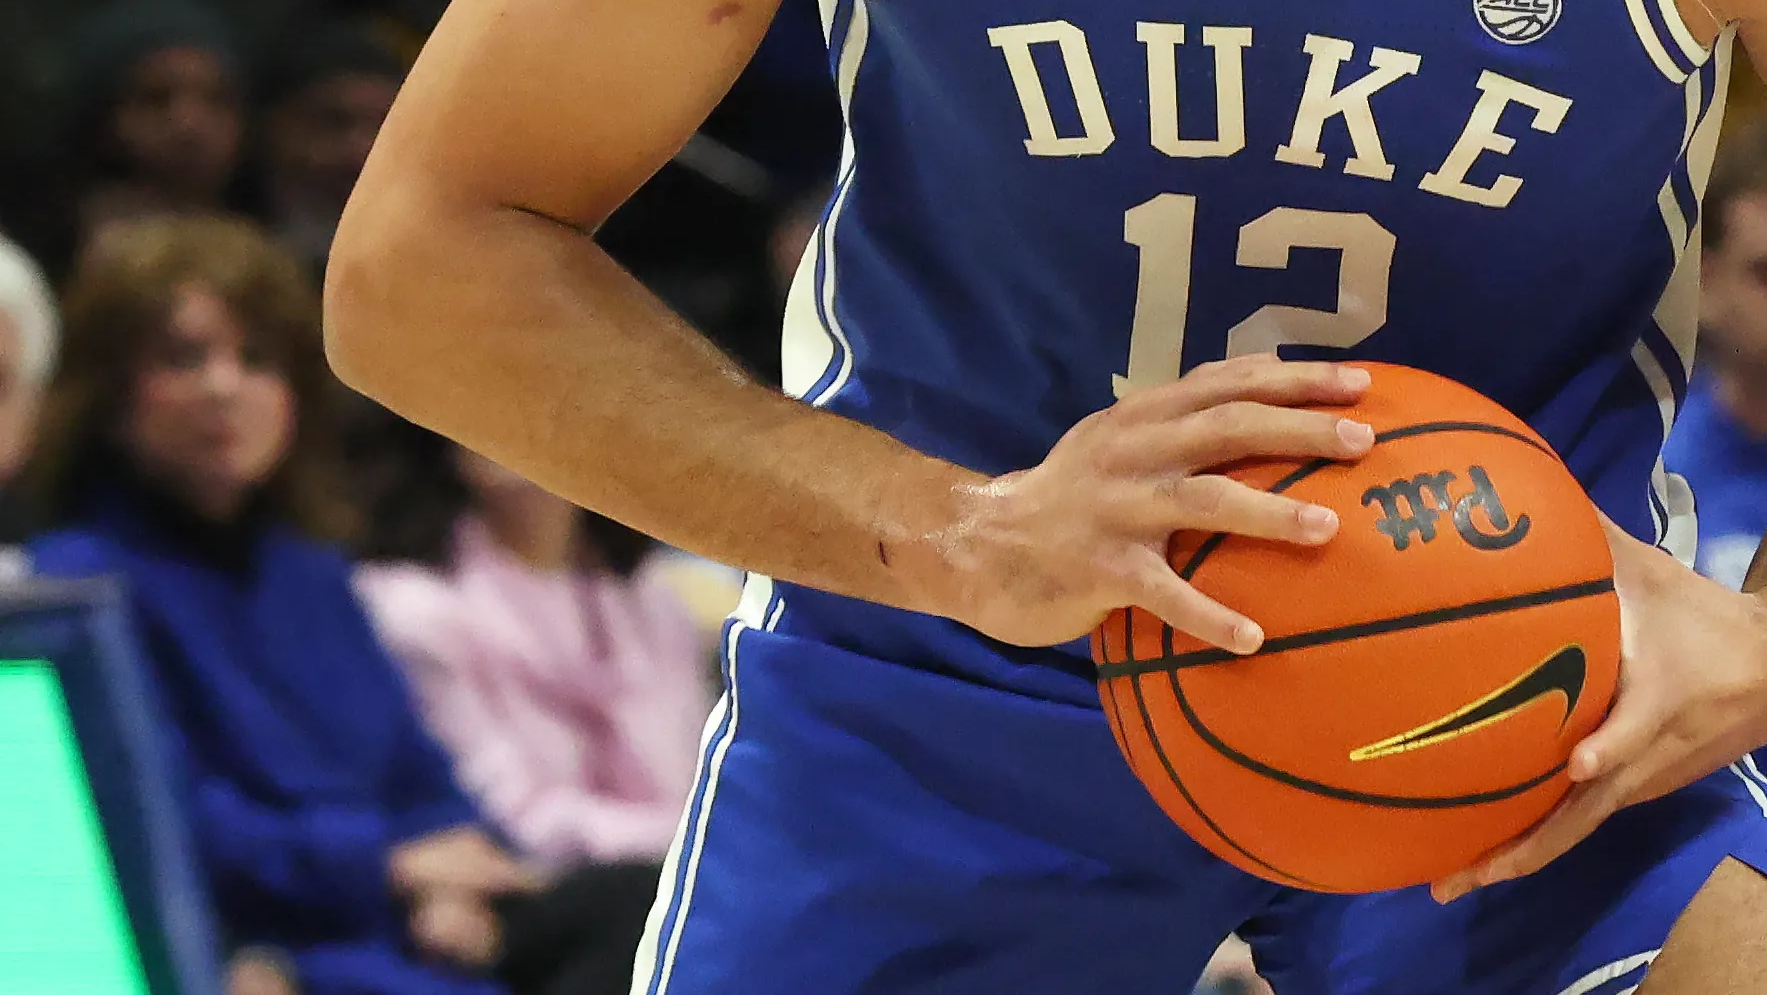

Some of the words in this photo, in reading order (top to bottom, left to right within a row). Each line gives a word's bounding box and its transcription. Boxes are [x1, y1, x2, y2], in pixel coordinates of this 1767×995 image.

[987, 19, 1573, 207] DUKE
[1111, 192, 1397, 401] 12
[1361, 465, 1531, 551] Pitt
